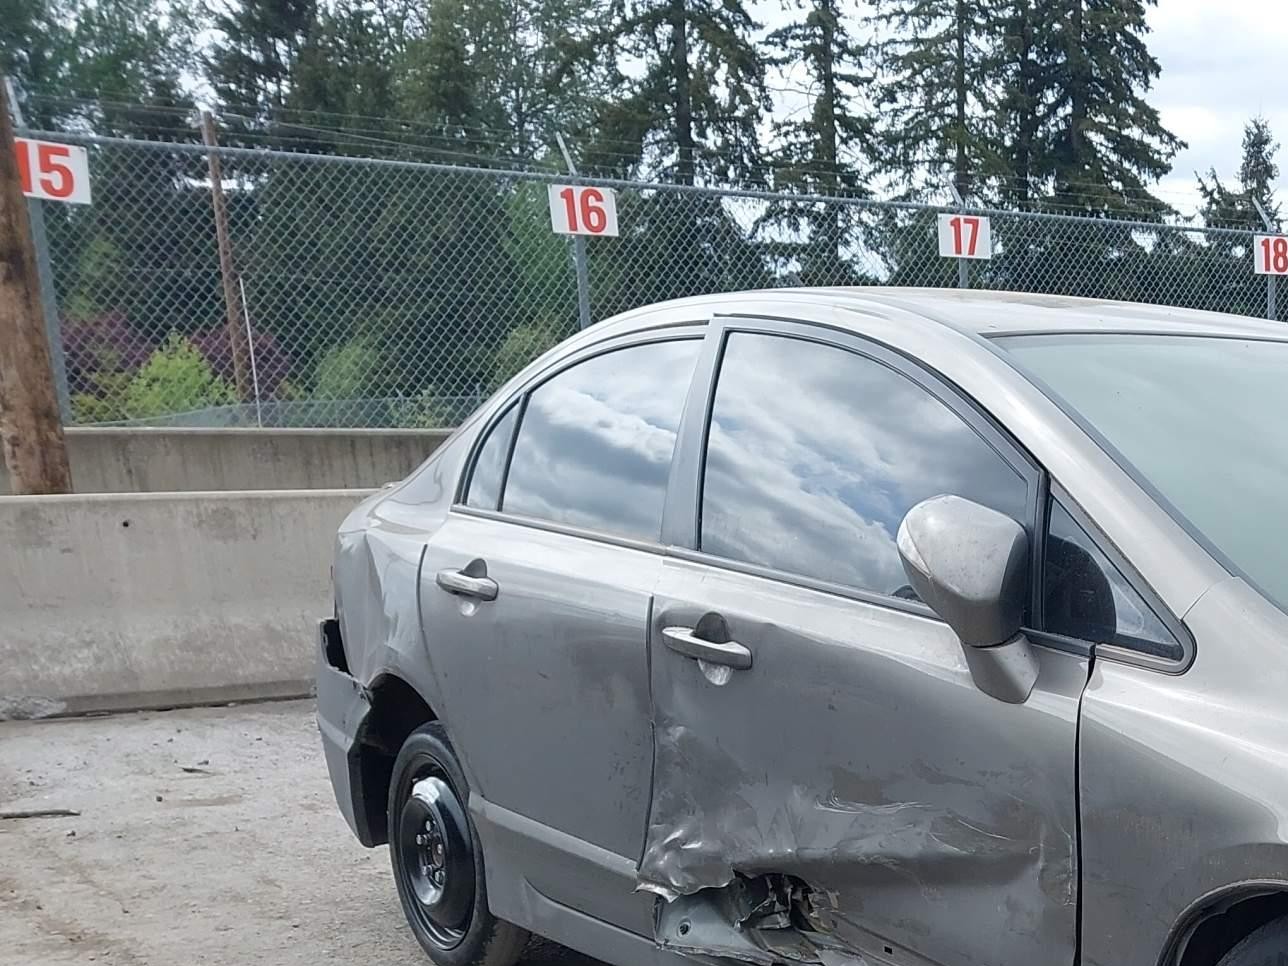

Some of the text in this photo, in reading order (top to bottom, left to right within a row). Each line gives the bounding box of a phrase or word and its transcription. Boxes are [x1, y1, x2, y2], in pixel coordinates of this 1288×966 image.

[560, 187, 607, 233] 16
[950, 217, 980, 256] 17
[1261, 237, 1288, 273] 18
